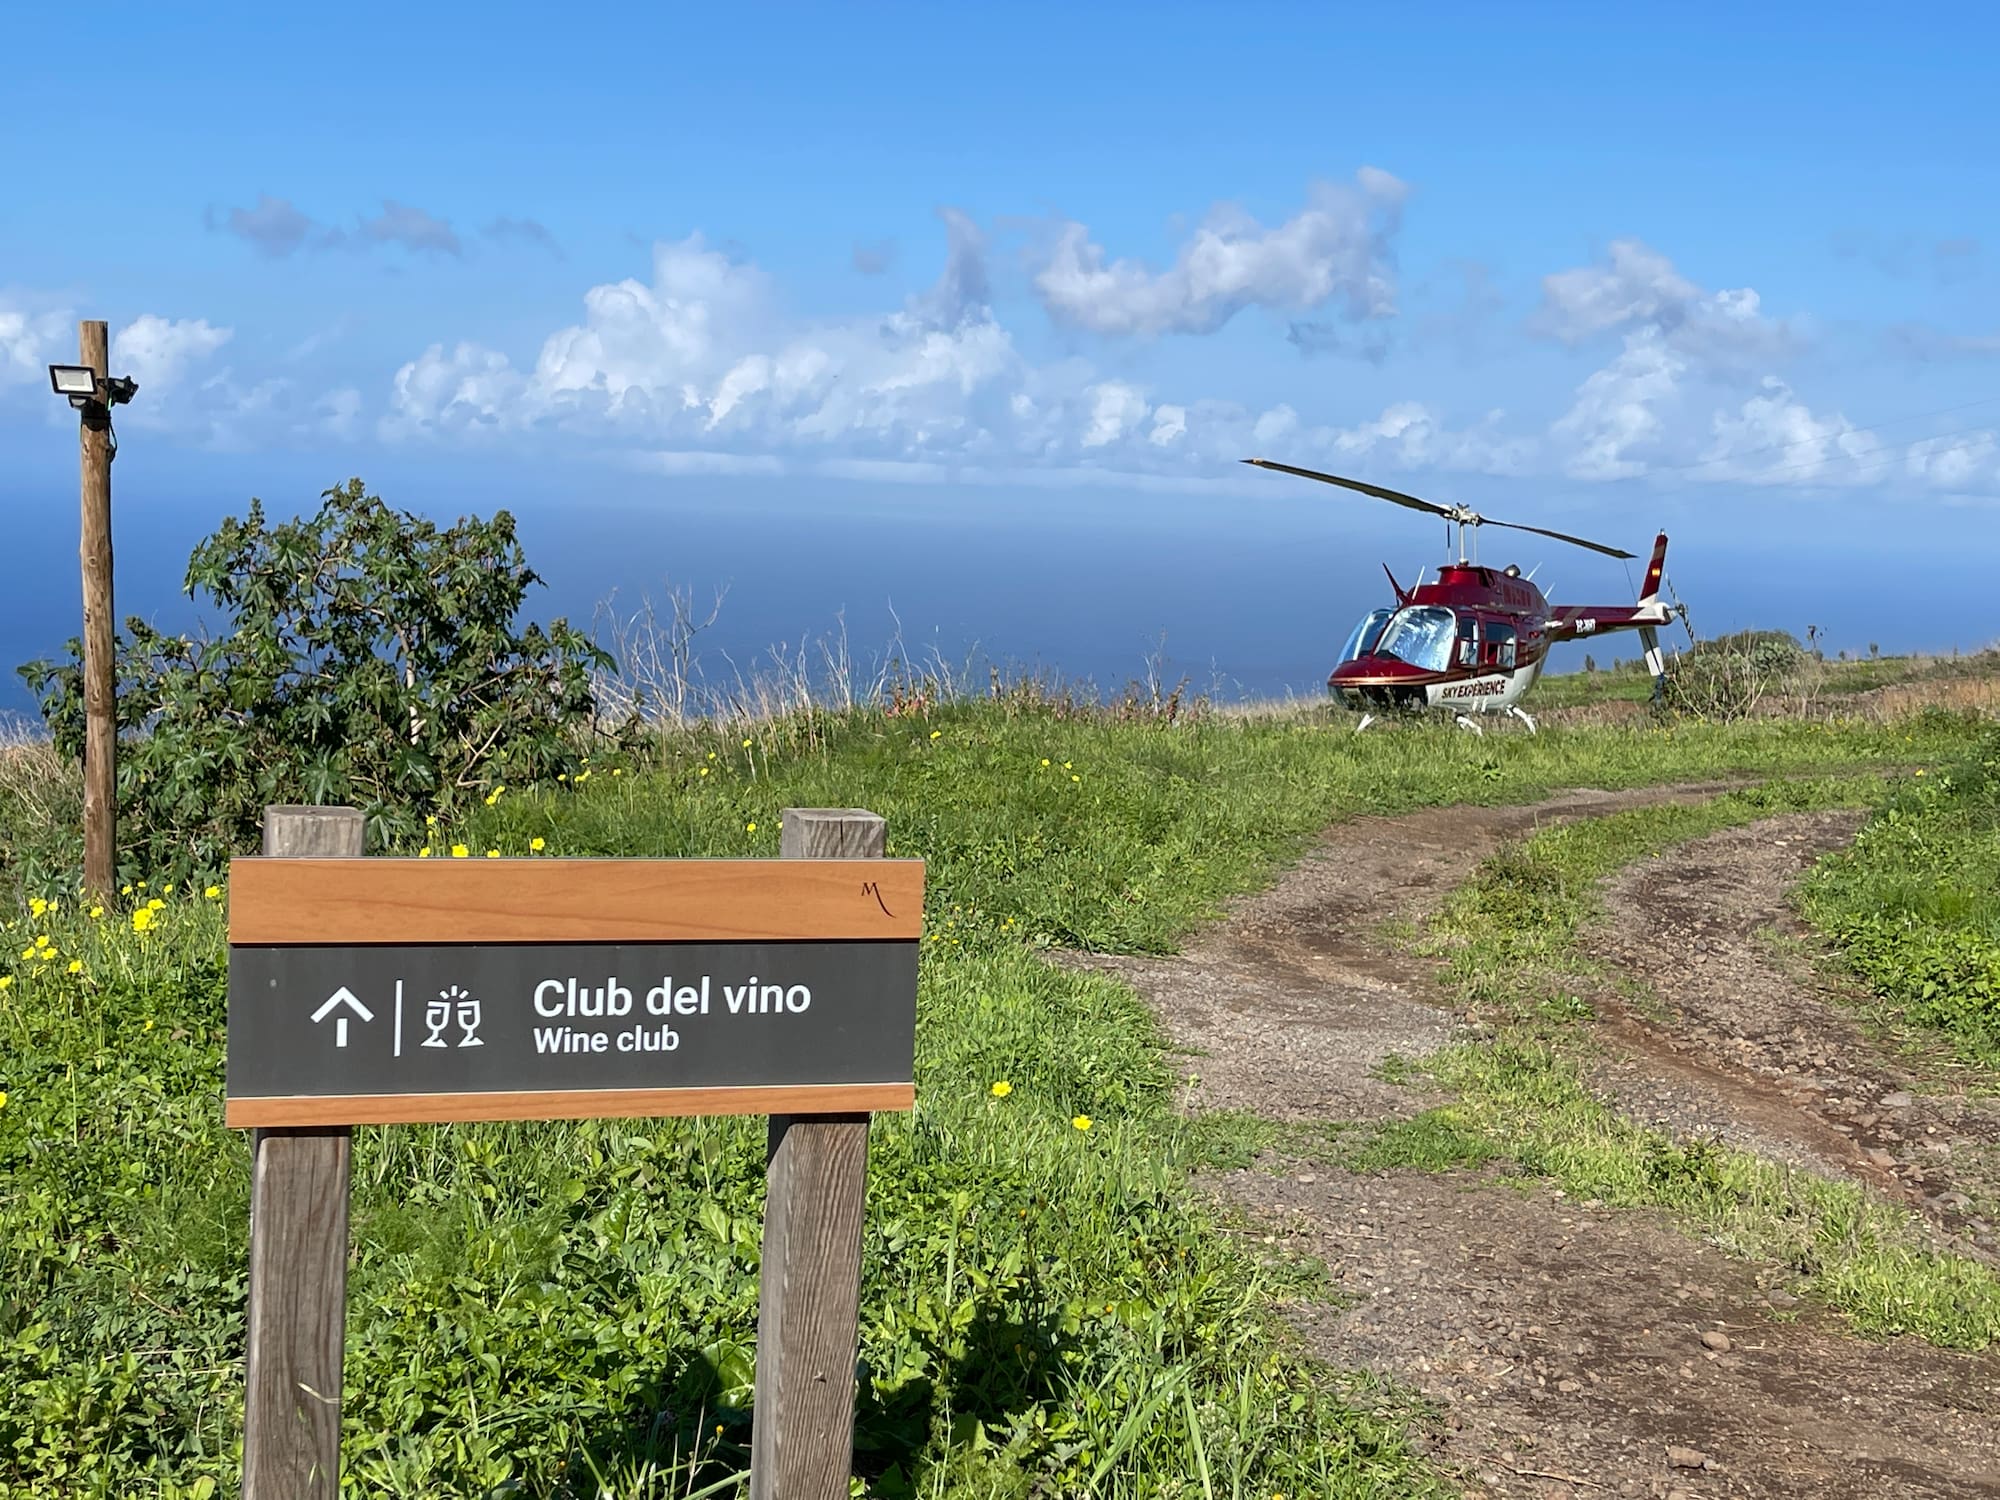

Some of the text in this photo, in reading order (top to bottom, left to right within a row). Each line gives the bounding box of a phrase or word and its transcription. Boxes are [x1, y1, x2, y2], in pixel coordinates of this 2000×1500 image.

[533, 975, 812, 1017] Club del vino
[533, 1024, 680, 1054] Wine club
